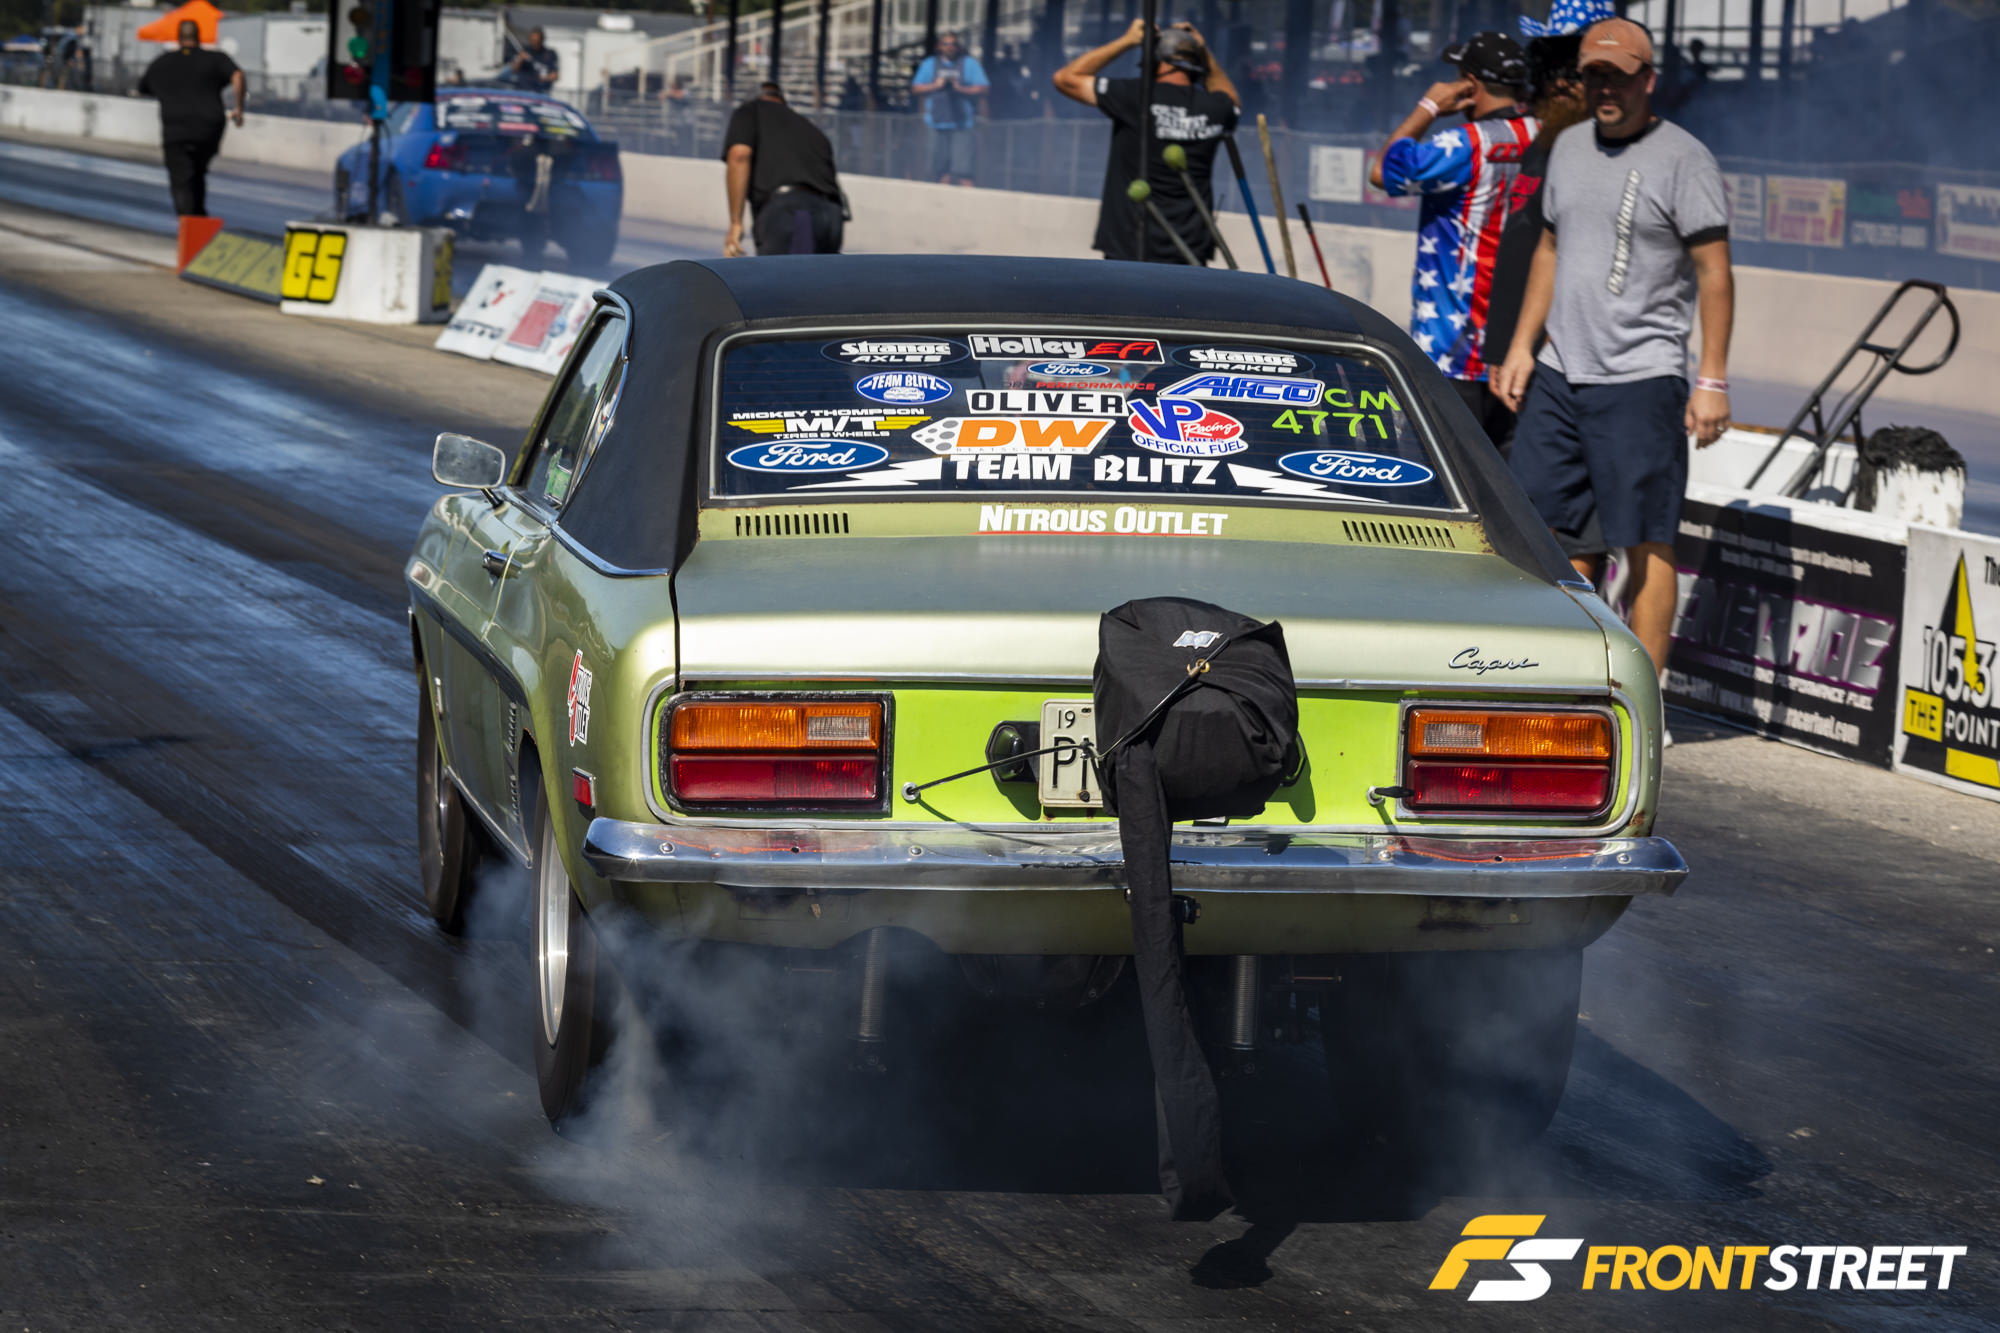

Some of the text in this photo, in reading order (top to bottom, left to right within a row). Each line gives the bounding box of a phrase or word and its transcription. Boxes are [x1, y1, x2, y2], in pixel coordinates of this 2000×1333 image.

[972, 336, 1155, 359] Holley EFI
[851, 355, 942, 363] AXLES
[1043, 362, 1094, 376] Ford
[1199, 362, 1292, 374] BRAKES
[871, 374, 938, 391] TEAM BLITZ
[1035, 381, 1156, 391] PERFORMANCE
[732, 408, 925, 420] MICKEY THOMPSON
[971, 392, 1123, 414] OLIVER
[785, 415, 885, 433] M/T
[1129, 398, 1204, 442] VP
[1183, 421, 1239, 437] Racing
[1271, 409, 1388, 440] 4771
[955, 419, 1110, 448] DW
[1134, 434, 1245, 455] OFFICIAL FUEL
[758, 443, 857, 467] Ford
[949, 453, 1221, 485] TEAM BLITZ
[1309, 453, 1402, 482] Ford
[1448, 646, 1540, 676] Capri
[1923, 624, 1997, 708] 105.3
[1057, 709, 1076, 729] 19
[1910, 699, 2000, 750] THE POINT
